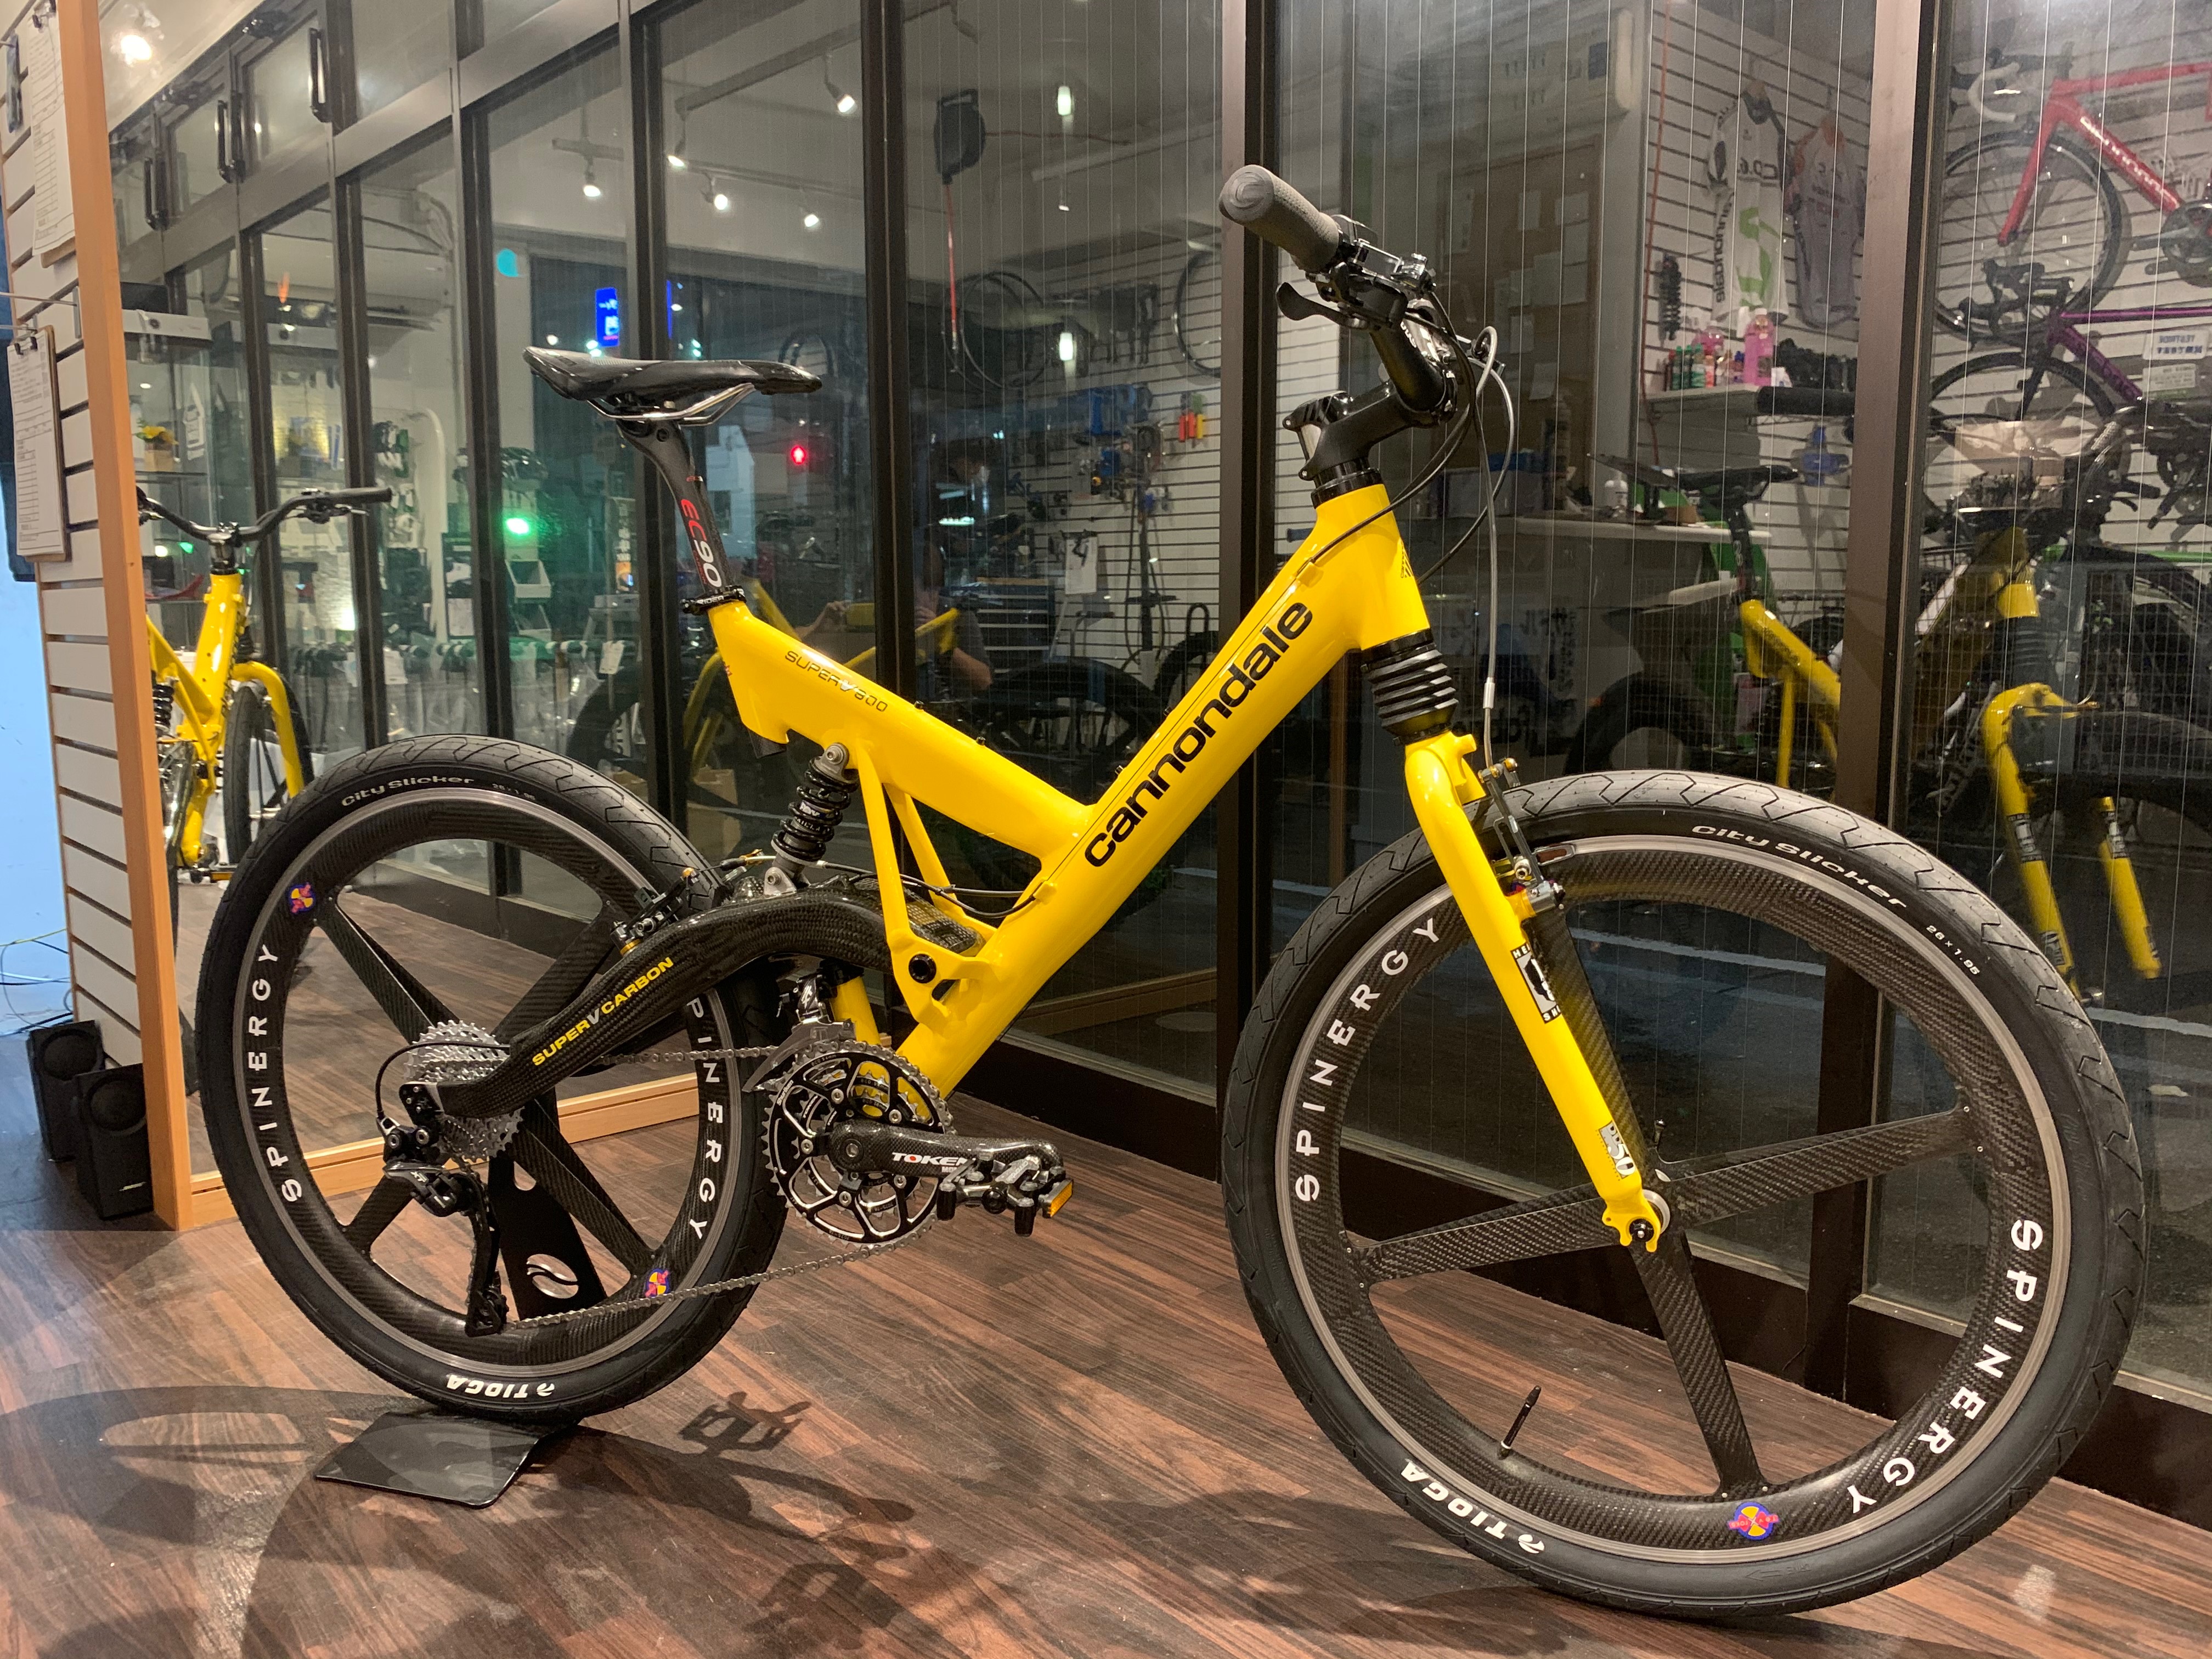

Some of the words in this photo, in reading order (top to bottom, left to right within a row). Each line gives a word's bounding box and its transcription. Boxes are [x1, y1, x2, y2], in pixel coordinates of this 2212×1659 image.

[681, 498, 723, 588] EC90
[341, 784, 385, 808] City
[388, 775, 475, 790] Slicker
[1084, 602, 1313, 867] cannondale
[1692, 824, 1769, 847] City
[1775, 841, 1908, 909] Slicker
[247, 944, 302, 1203] SPINERGY
[686, 997, 724, 1240] PINERGY
[1295, 917, 1440, 1202] SPINERGY
[447, 1374, 530, 1399] TIOGA
[1846, 1218, 2044, 1513] SPINERGY
[1400, 1459, 1510, 1541] TIOGA
